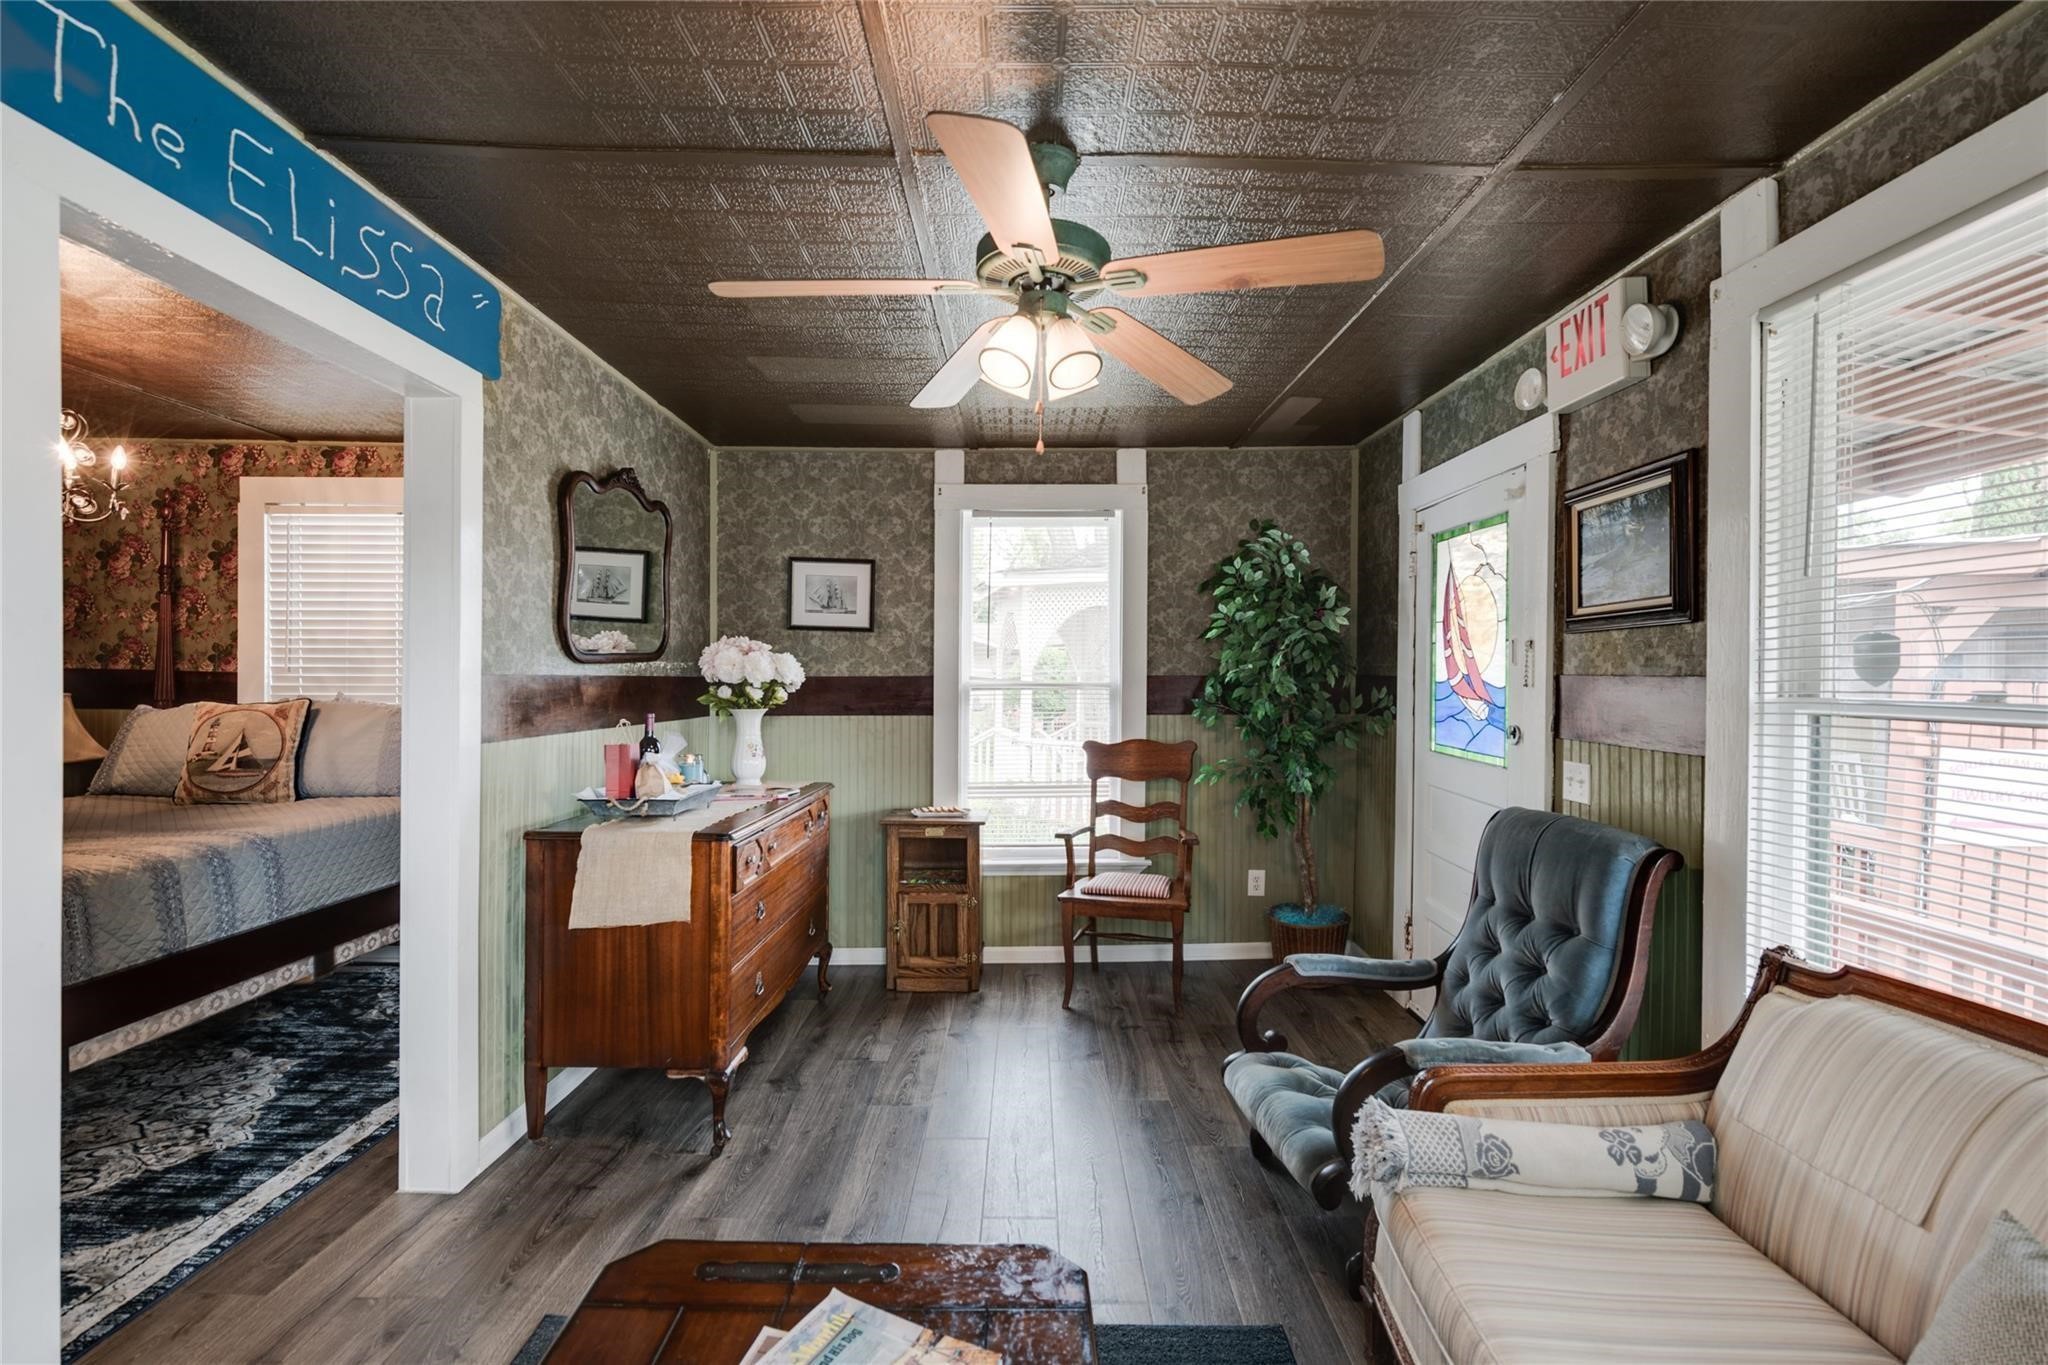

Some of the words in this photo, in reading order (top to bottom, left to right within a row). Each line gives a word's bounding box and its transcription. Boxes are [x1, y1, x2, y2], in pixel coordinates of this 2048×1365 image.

[34, 0, 186, 170] The
[1558, 293, 1610, 379] EXIT
[827, 1342, 847, 1357] His
[840, 1327, 864, 1345] Dog
